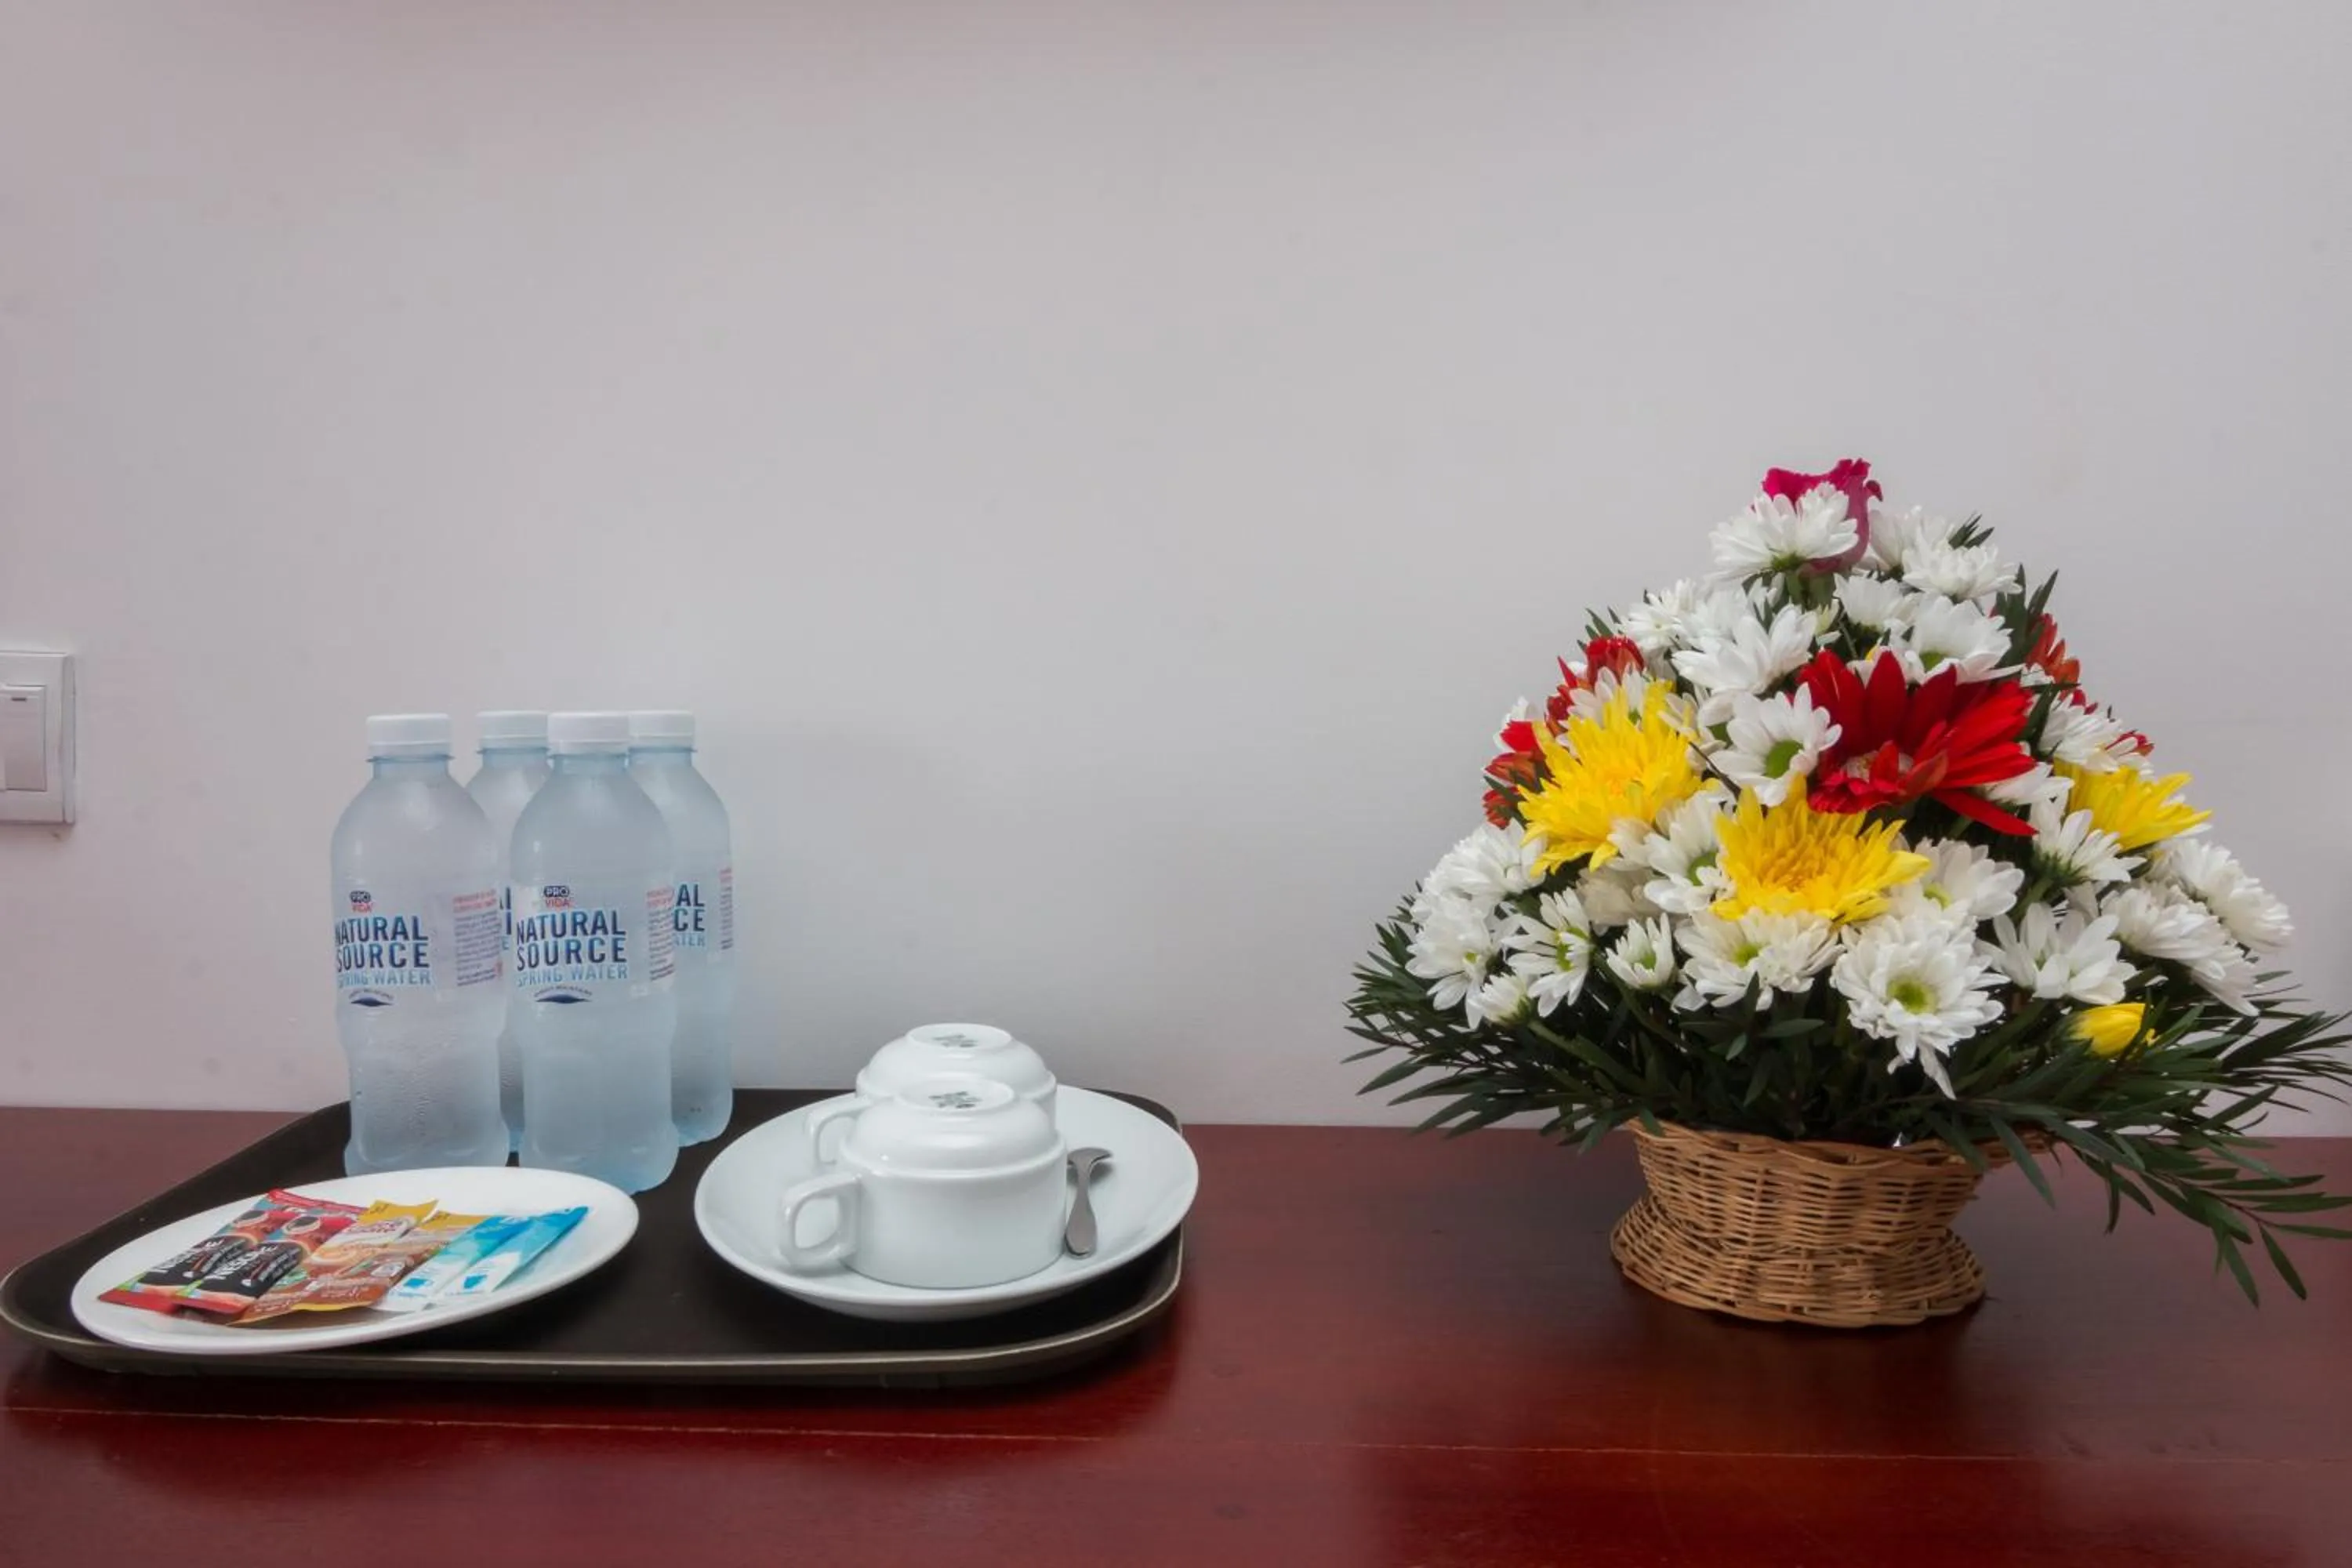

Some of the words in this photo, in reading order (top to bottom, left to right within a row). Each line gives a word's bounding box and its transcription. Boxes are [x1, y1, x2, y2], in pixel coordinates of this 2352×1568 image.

[545, 885, 569, 897] PRO
[336, 916, 429, 947] NATURAL
[517, 910, 626, 946] NATURAL
[337, 942, 430, 972] SOURCE
[517, 937, 626, 971] SOURCE
[375, 969, 430, 985] WATER
[571, 964, 627, 982] WATER
